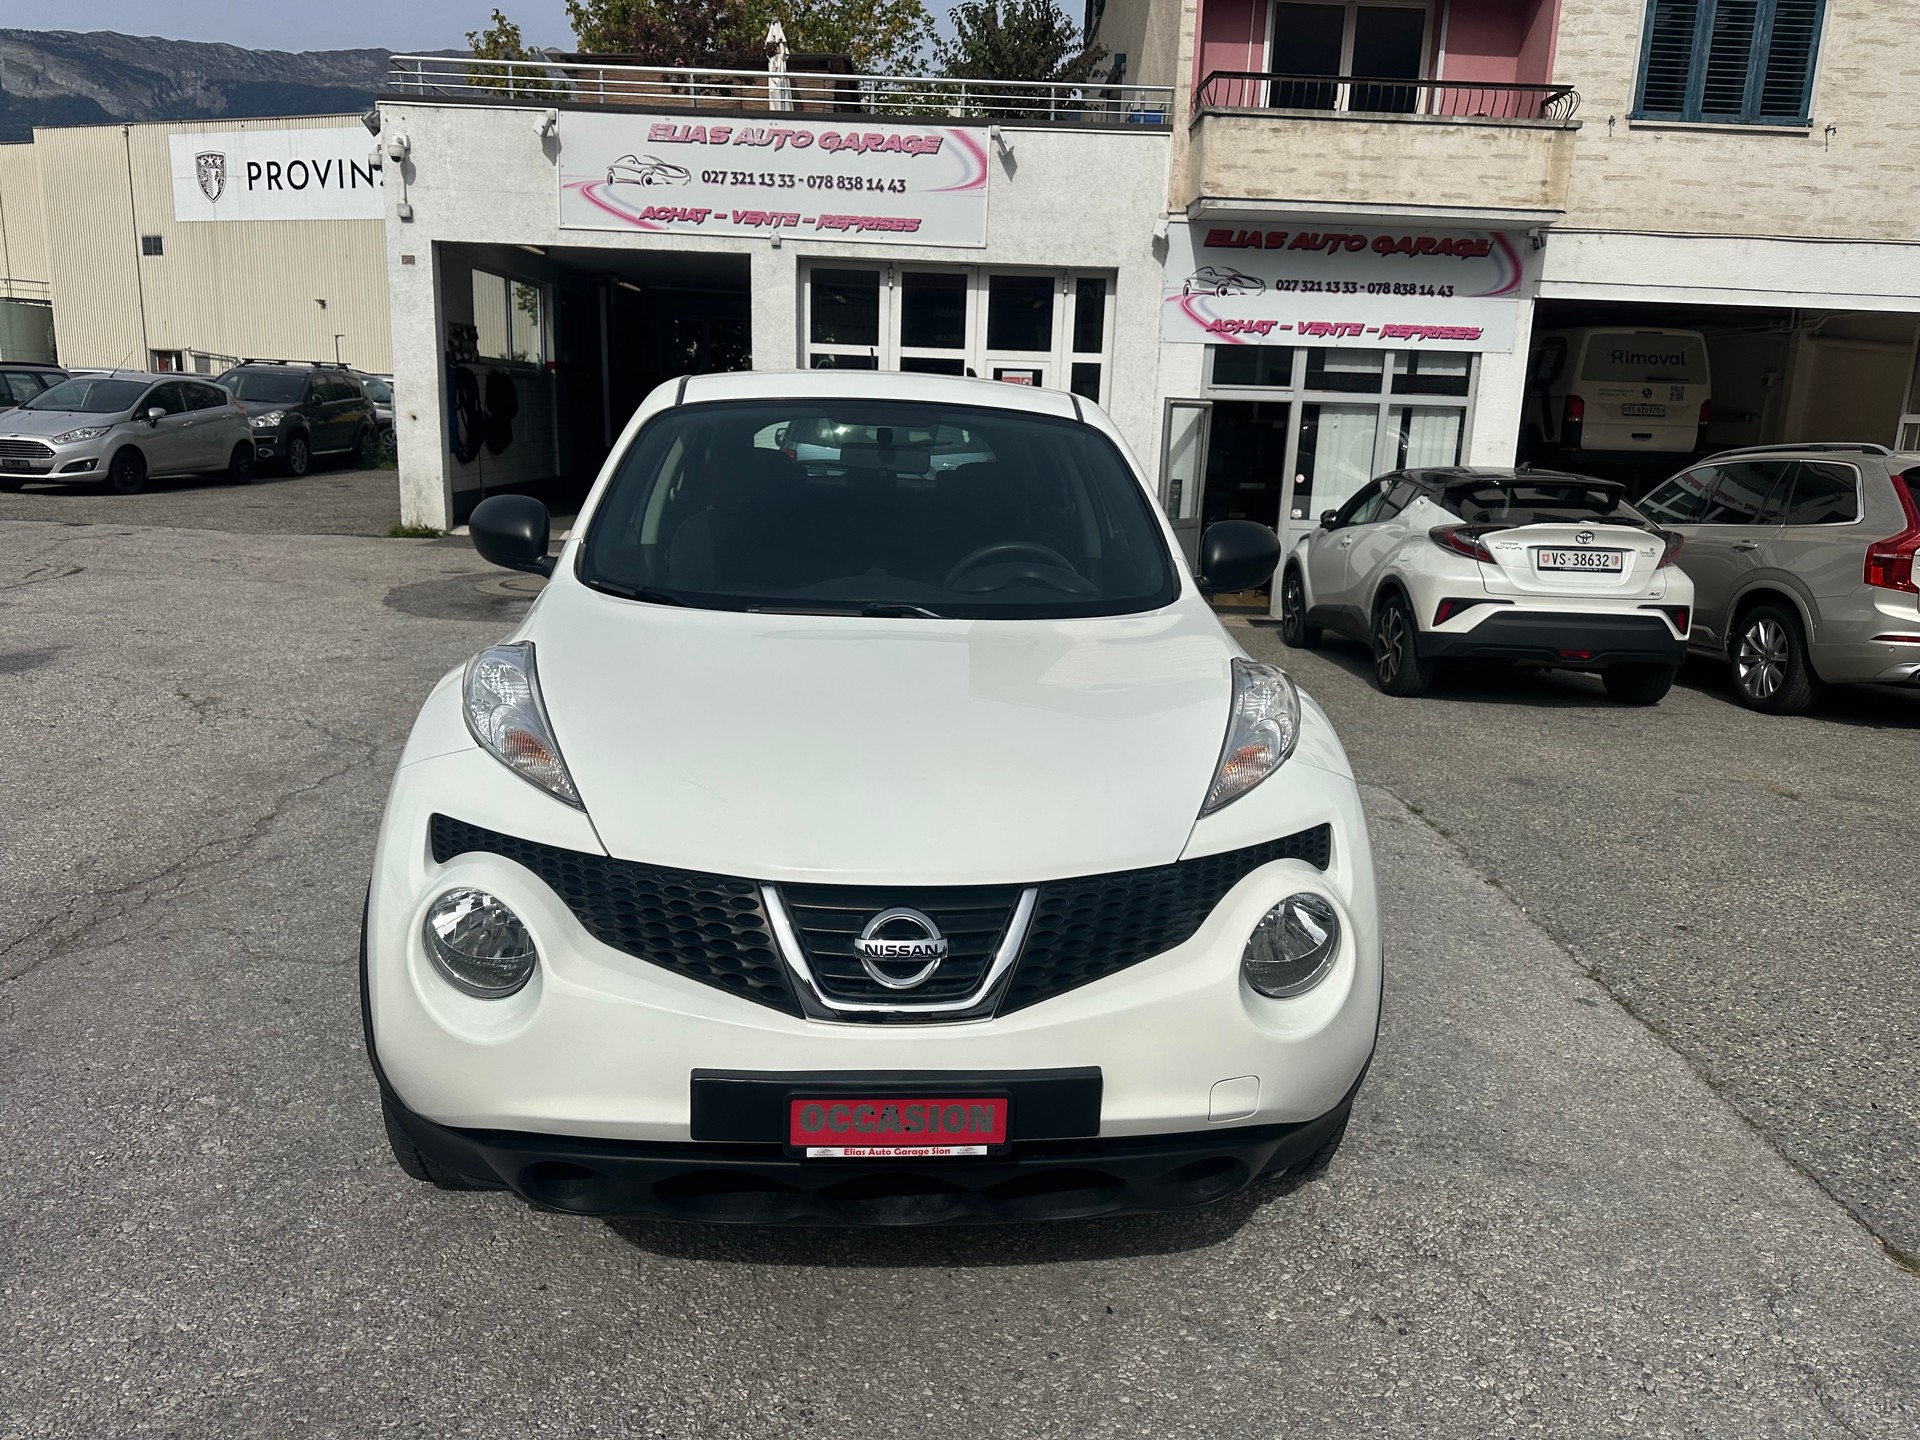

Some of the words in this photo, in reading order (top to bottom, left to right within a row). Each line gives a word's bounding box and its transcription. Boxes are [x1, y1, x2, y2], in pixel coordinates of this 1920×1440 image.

[647, 123, 731, 146] ELIAS
[732, 126, 814, 151] AUTO
[817, 131, 943, 157] GARAGE
[246, 158, 384, 191] PROVIN
[701, 170, 727, 184] 027
[730, 171, 755, 186] 321
[758, 172, 775, 187] 13
[777, 173, 795, 188] 33
[806, 176, 834, 190] 078
[837, 177, 863, 191] 838
[866, 178, 884, 192] 14
[887, 180, 907, 193] 43
[638, 205, 711, 225] ACHAT
[731, 209, 800, 227] VENTE
[815, 214, 922, 233] REPRISES
[1204, 228, 1288, 250] ELIAS
[1288, 233, 1368, 255] AUTO
[1371, 234, 1494, 260] GARAGE
[1276, 279, 1299, 292] 027
[1301, 280, 1323, 293] 321
[1325, 281, 1340, 294] 13
[1342, 282, 1358, 294] 33
[1367, 282, 1391, 296] 078
[1392, 283, 1416, 296] 838
[1419, 284, 1435, 297] 14
[1437, 285, 1454, 298] 43
[1205, 319, 1277, 336] ACHAT
[1297, 321, 1365, 339] VENTE
[1378, 325, 1484, 341] REPRISES
[1611, 350, 1687, 366] Rimoval
[864, 944, 938, 957] NISSAN
[801, 1104, 994, 1133] OCCASION
[844, 1148, 865, 1156] Elias
[868, 1148, 891, 1156] Auto
[894, 1147, 929, 1156] Garage
[932, 1147, 950, 1155] Sion
